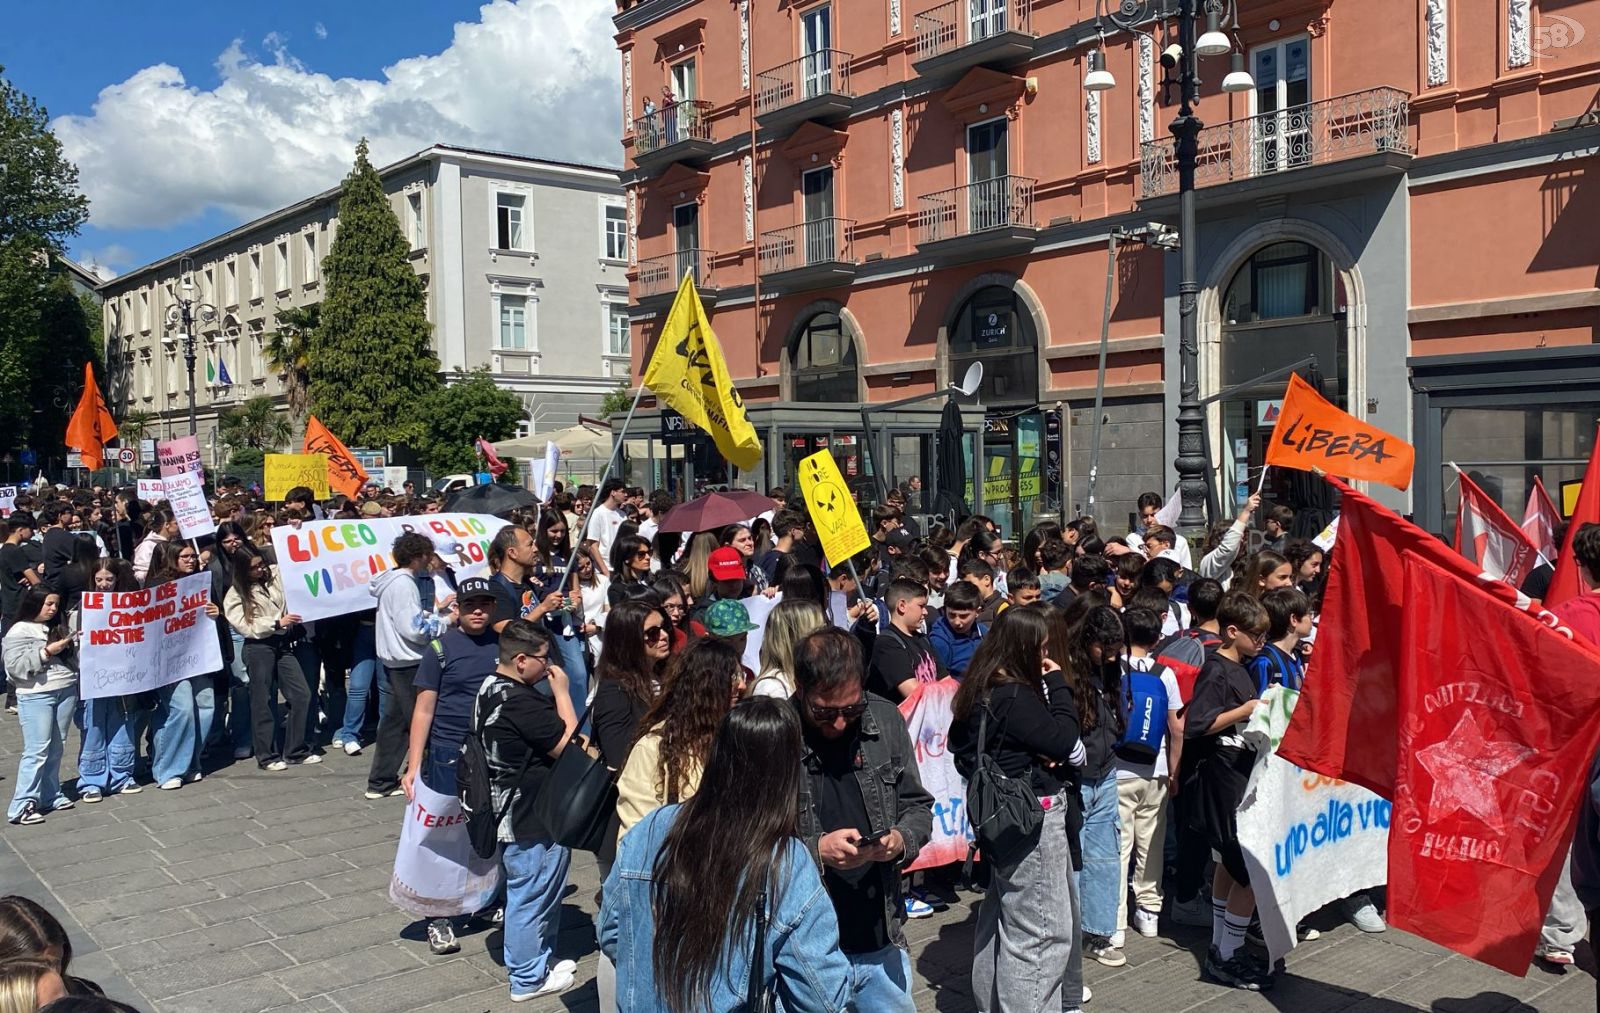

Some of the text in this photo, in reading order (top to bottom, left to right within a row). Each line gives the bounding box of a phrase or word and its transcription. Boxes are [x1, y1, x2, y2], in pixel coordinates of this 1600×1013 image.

[981, 327, 1006, 336] ZURICH
[122, 452, 132, 460] 30
[808, 467, 829, 486] MORE
[287, 517, 487, 563] LICEO PBLIO
[462, 581, 489, 593] ICON
[84, 592, 104, 609] LE
[111, 588, 151, 609] LORO
[179, 589, 208, 613] SULLE
[90, 626, 145, 645] NOSTRE
[1140, 697, 1153, 741] HEAD
[1311, 799, 1353, 844] alla
[1357, 799, 1392, 830] vio
